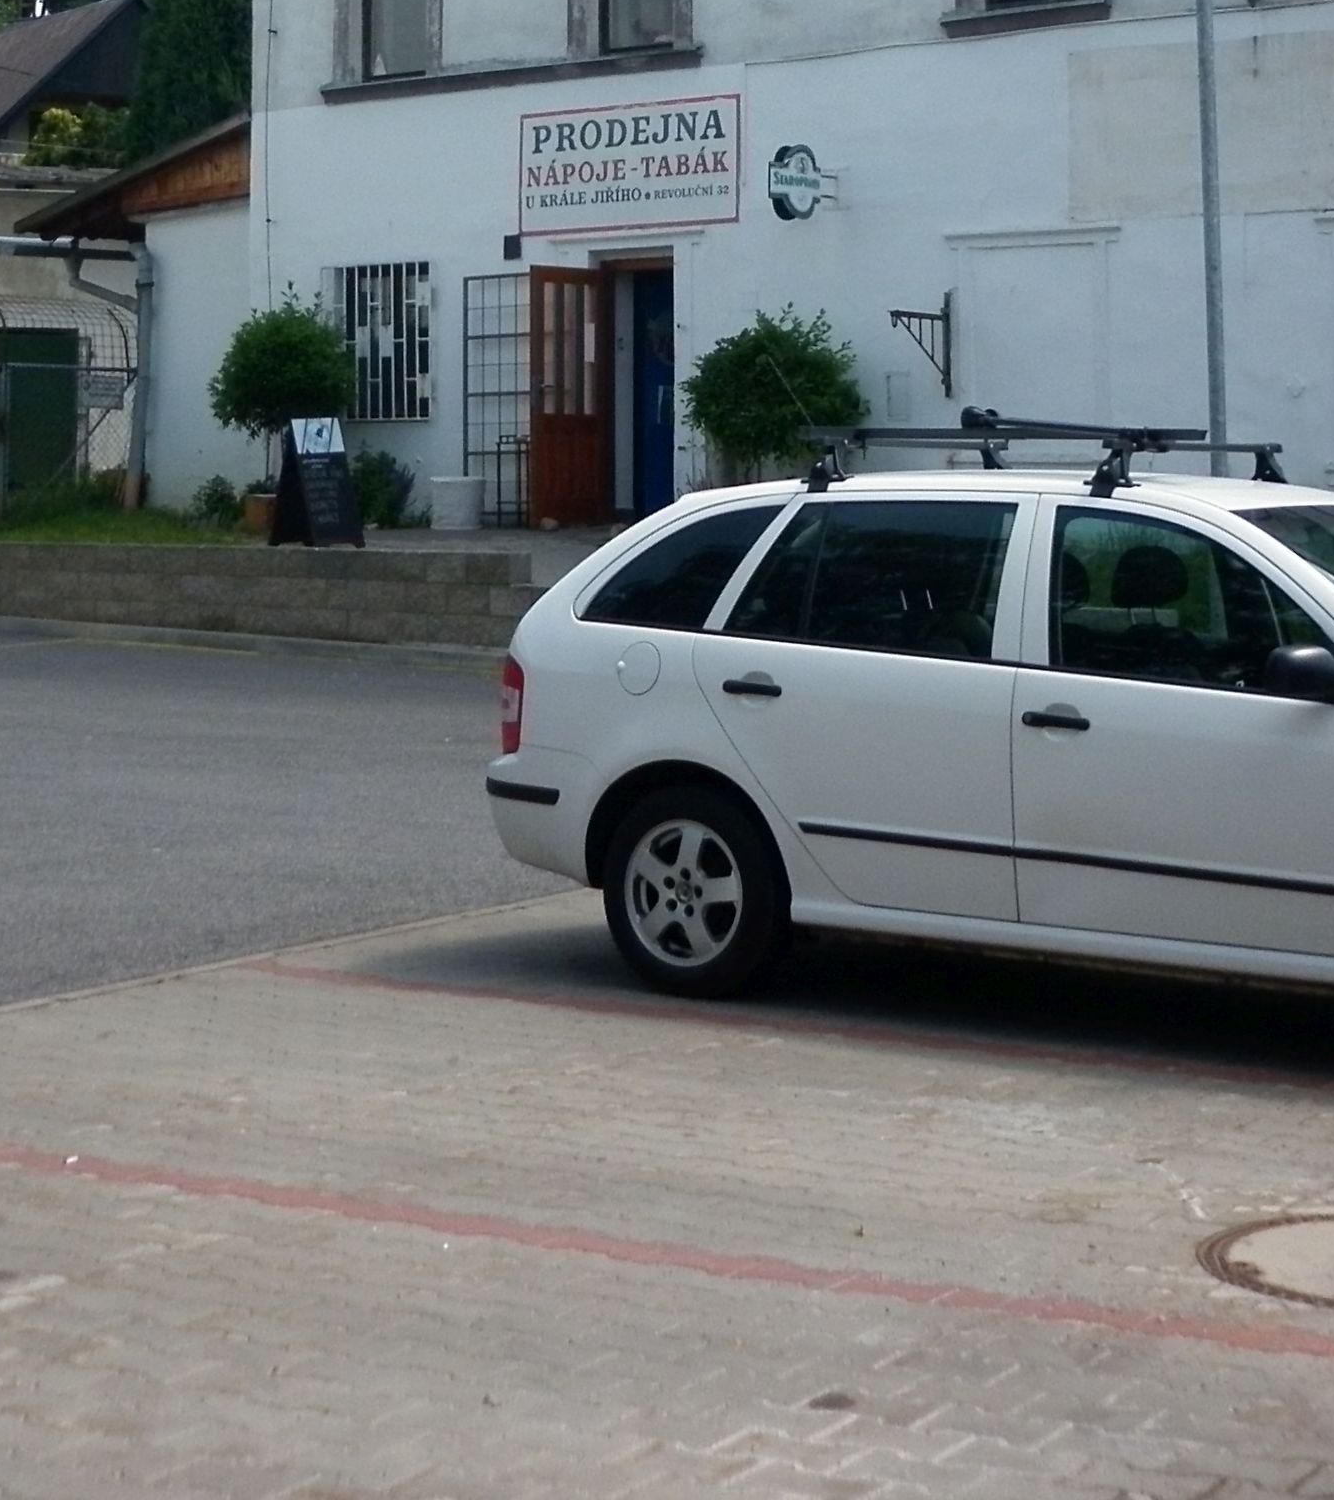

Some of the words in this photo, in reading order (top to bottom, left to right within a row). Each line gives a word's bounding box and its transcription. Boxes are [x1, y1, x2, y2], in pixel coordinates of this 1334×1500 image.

[532, 109, 726, 154] PRODEJNA
[526, 196, 535, 209] U
[540, 189, 586, 208] KRÁLE
[591, 187, 642, 204] JIŘÍHO
[654, 185, 713, 200] REVOLUČNÍ
[716, 185, 729, 196] 32
